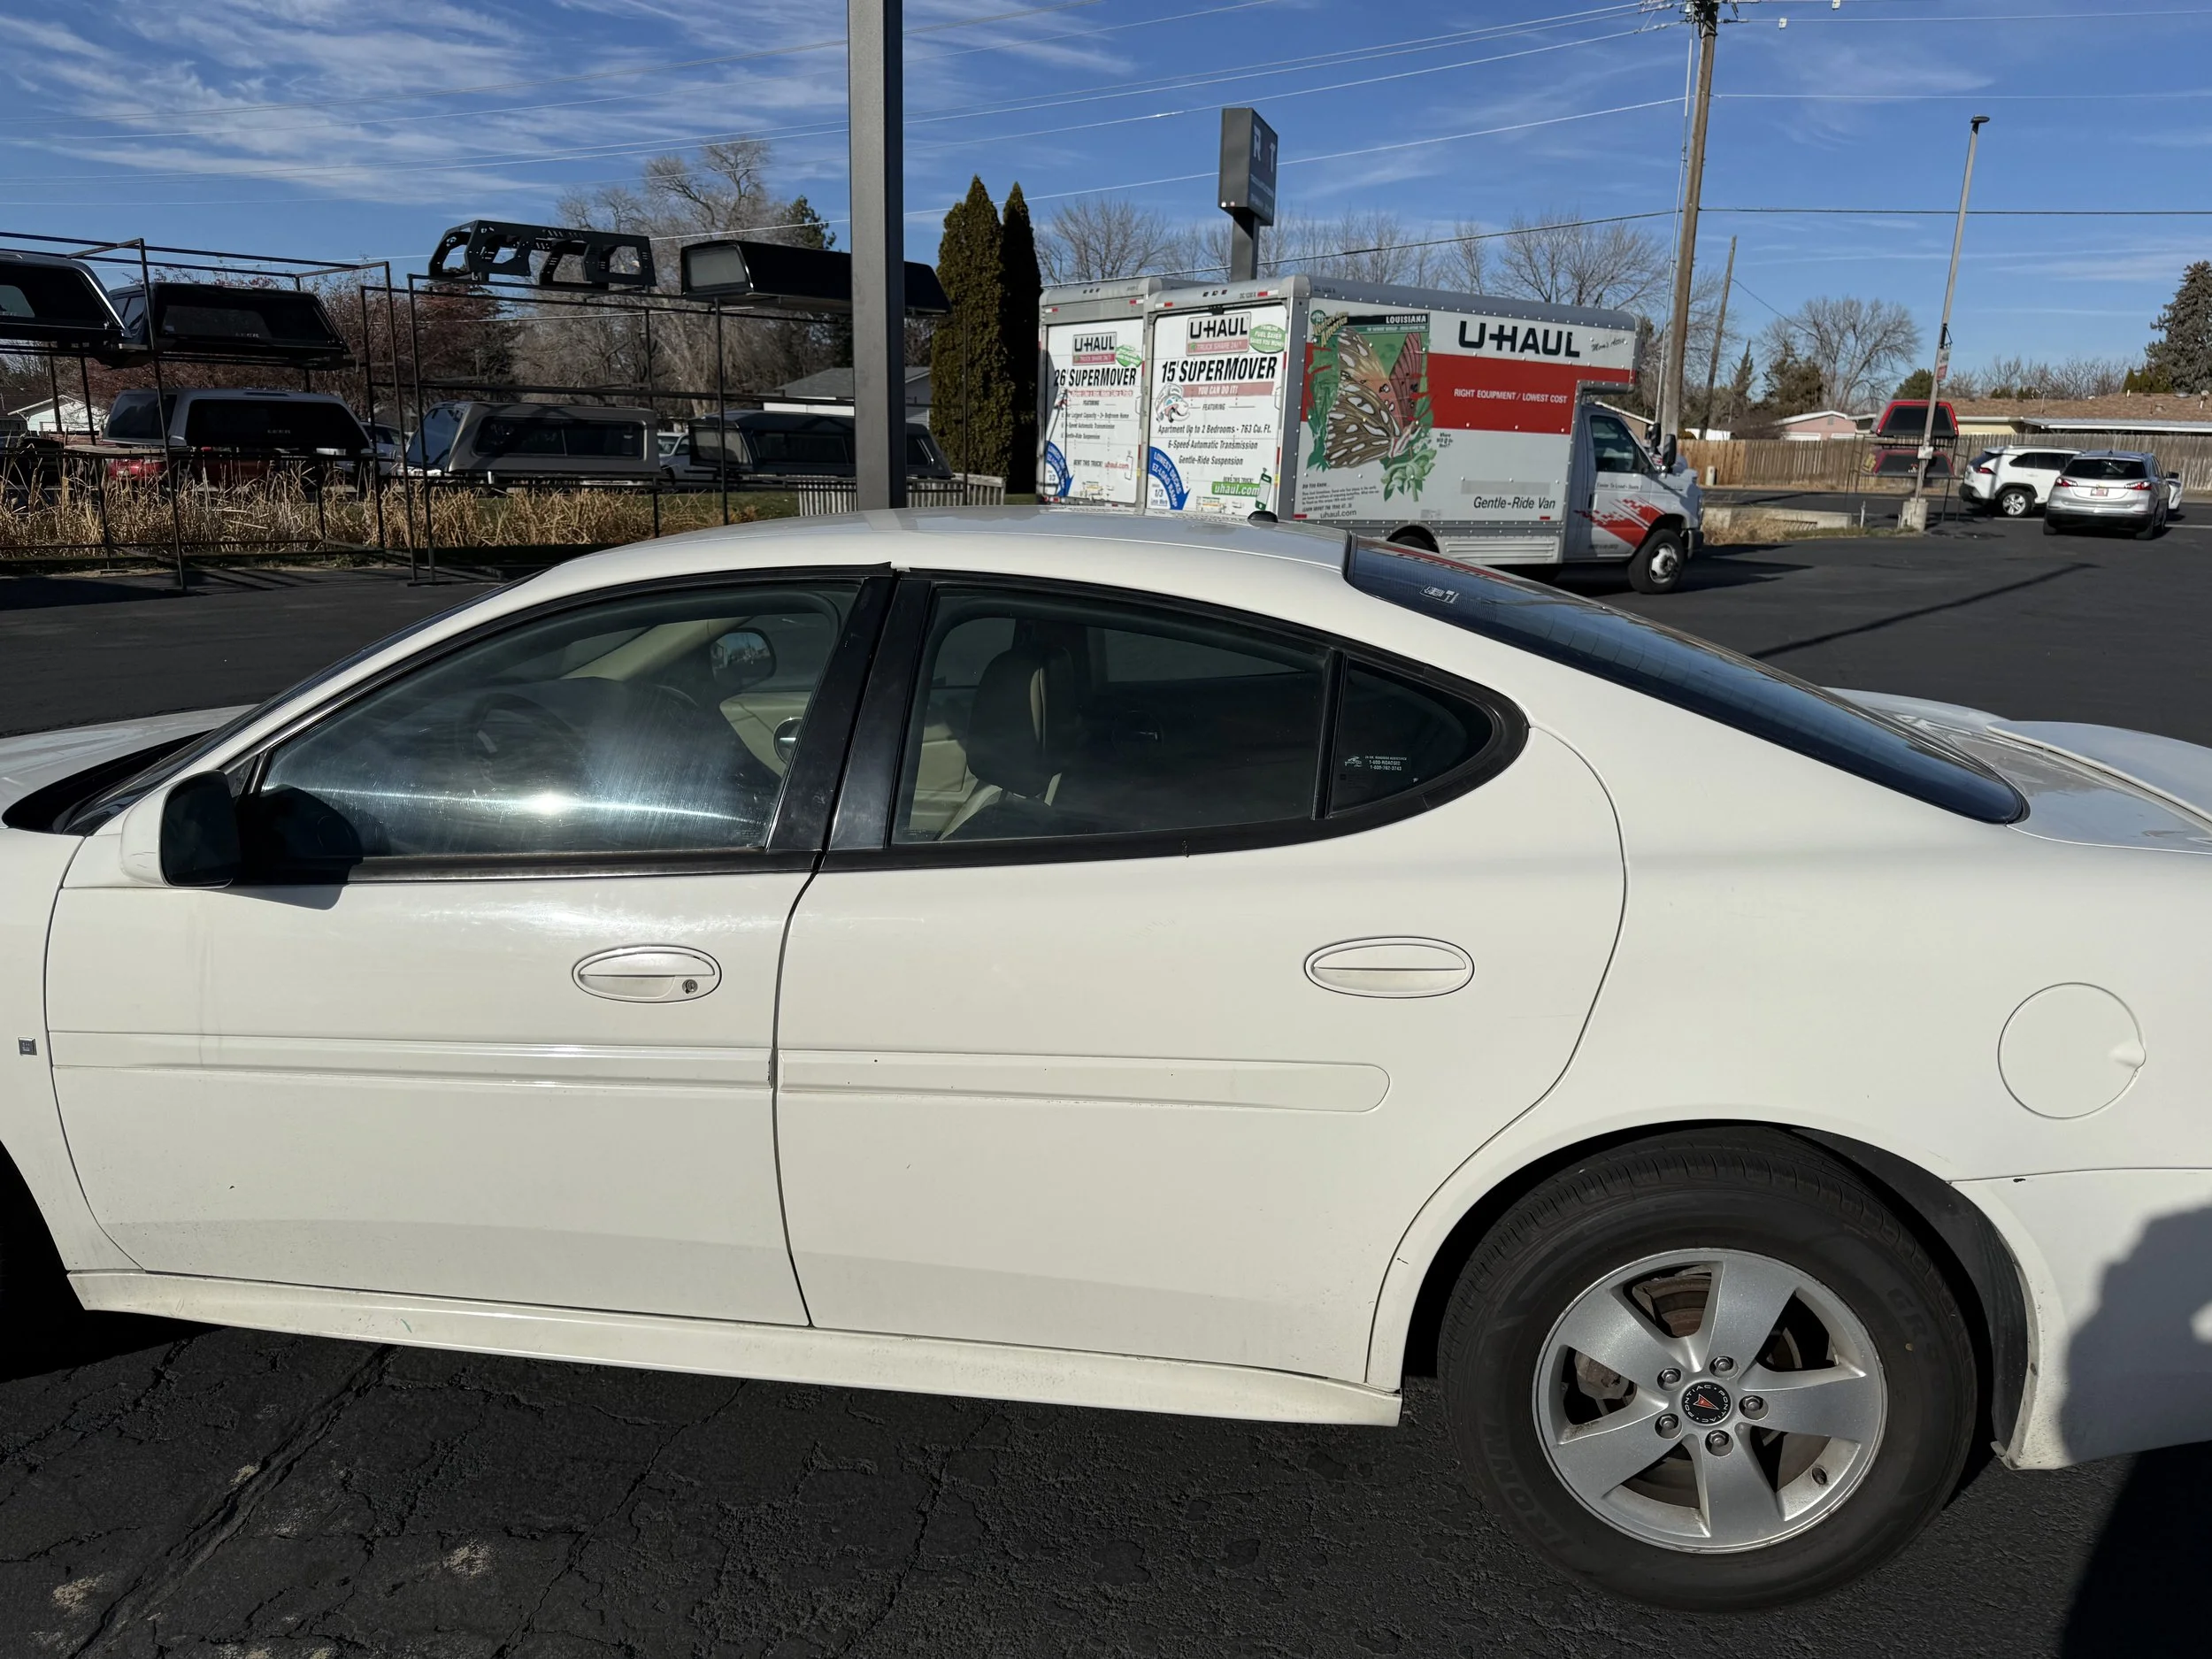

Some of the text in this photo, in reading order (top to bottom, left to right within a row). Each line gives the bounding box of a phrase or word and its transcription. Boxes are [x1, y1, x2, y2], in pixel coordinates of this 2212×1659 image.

[1385, 315, 1426, 324] LOUISIANA
[1190, 317, 1248, 339] U-HAUL
[1074, 335, 1114, 352] U-HAUL
[1458, 320, 1580, 358] U-HAUL
[1069, 367, 1137, 387] SUPERMOVER
[1179, 357, 1278, 383] SUPERMOVER
[1209, 386, 1220, 395] CAN
[1222, 386, 1230, 395] DO
[1454, 388, 1475, 397] RIGHT
[1477, 389, 1516, 400] EQUIPMENT
[1522, 393, 1548, 403] LOWEST
[1550, 395, 1568, 403] COST
[1157, 425, 1185, 434] Apartment
[1186, 425, 1194, 434] Up
[1202, 425, 1206, 434] 2
[1206, 425, 1235, 434] Bedrooms
[1190, 441, 1218, 449] Automatic
[1219, 441, 1258, 449] Transmission
[1179, 455, 1244, 466] Gentle-Ride Suspension
[1214, 483, 1260, 495] uhaul.com
[1473, 495, 1555, 510] Gentle-Ride Van
[1320, 510, 1357, 518] uhaul.com
[1684, 1384, 1729, 1423] PONTIAC PONTIAC
